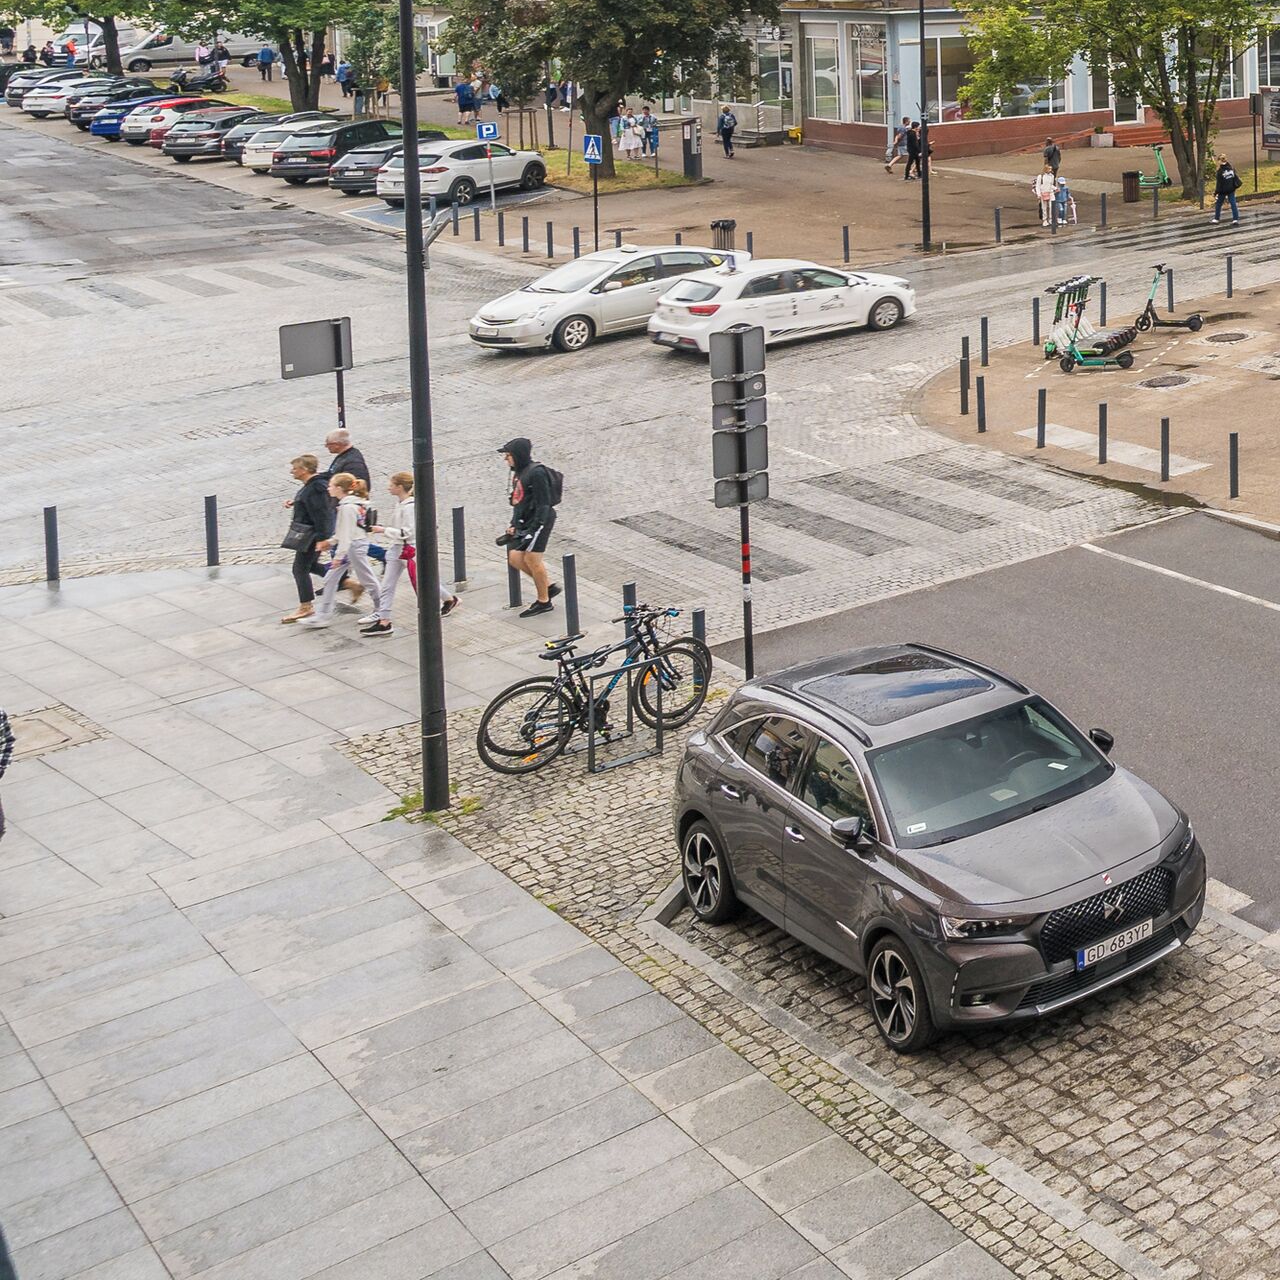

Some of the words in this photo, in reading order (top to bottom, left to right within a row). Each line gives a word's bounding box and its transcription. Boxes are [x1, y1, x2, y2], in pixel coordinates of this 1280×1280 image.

[482, 125, 494, 137] P
[1087, 944, 1105, 963] GD
[1110, 923, 1150, 952] 683YP
